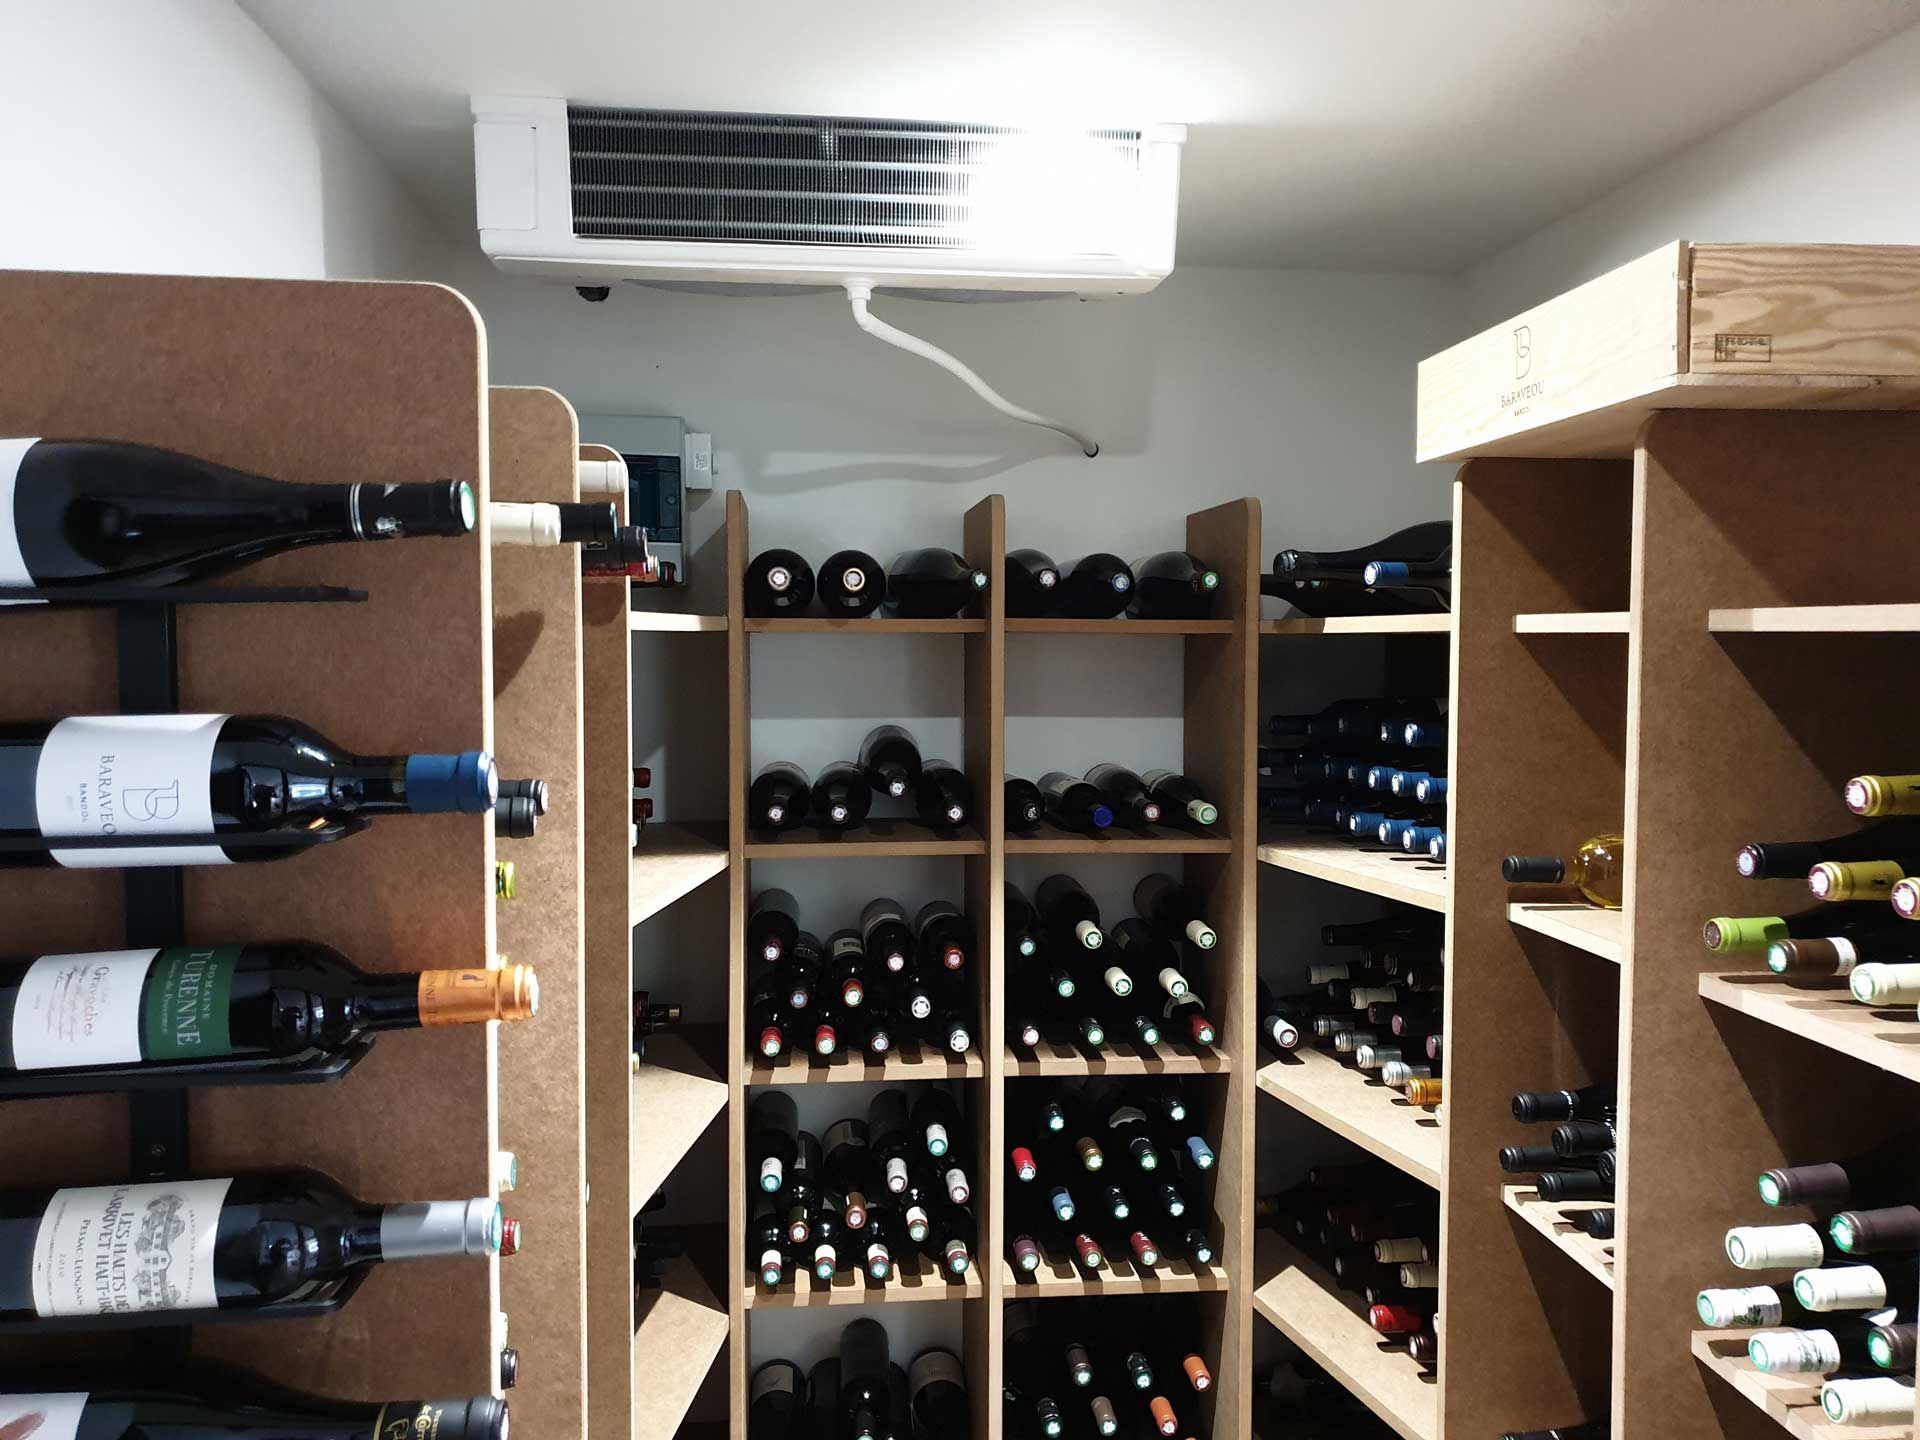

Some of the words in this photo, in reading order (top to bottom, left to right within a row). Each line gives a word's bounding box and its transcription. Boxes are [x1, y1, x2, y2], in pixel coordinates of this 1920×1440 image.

[1501, 380, 1545, 408] BARAVEOU
[79, 783, 89, 824] BANDOL
[98, 754, 117, 835] BARAVEO
[83, 966, 110, 1037] Gravoches
[176, 949, 215, 1047] TURENNE
[201, 963, 218, 1019] DOMAINE
[98, 1187, 130, 1250] LARRIVET
[115, 1211, 135, 1239] LES
[58, 1252, 67, 1279] 2010
[112, 1242, 128, 1291] HAUTS
[114, 1295, 130, 1311] DE
